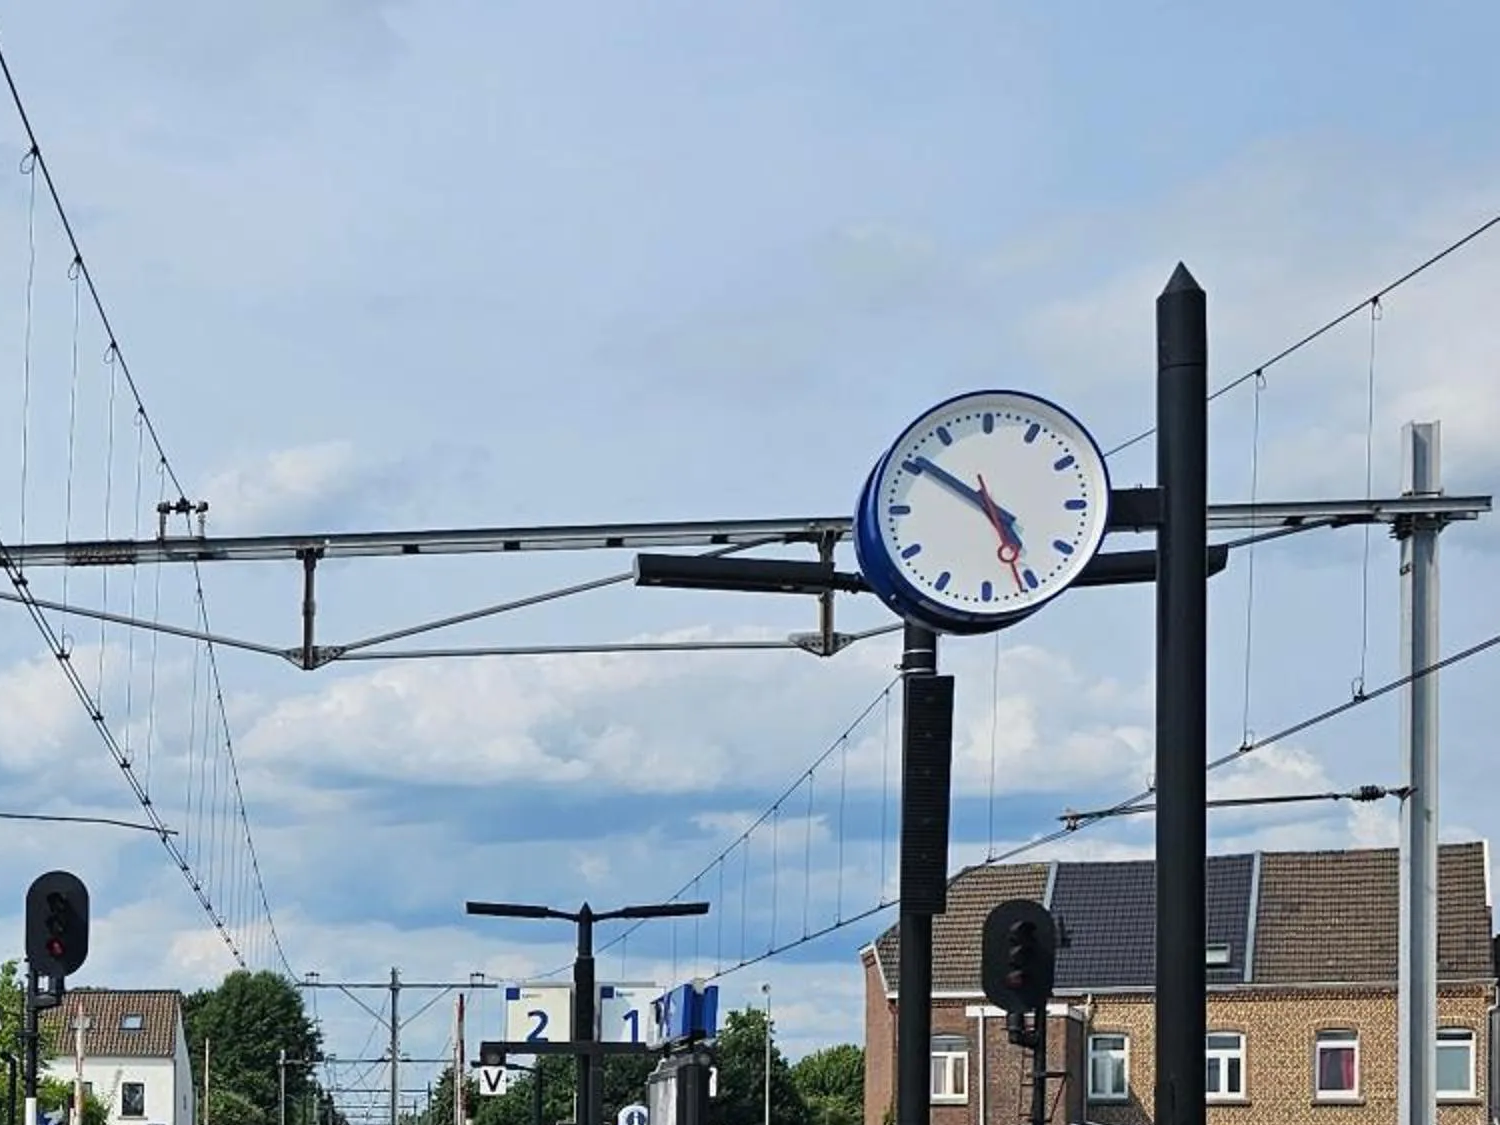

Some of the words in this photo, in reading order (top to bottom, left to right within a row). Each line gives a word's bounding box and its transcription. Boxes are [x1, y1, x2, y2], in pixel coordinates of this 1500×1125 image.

[526, 1009, 549, 1042] 2
[622, 1009, 639, 1042] 1
[483, 1069, 503, 1093] V
